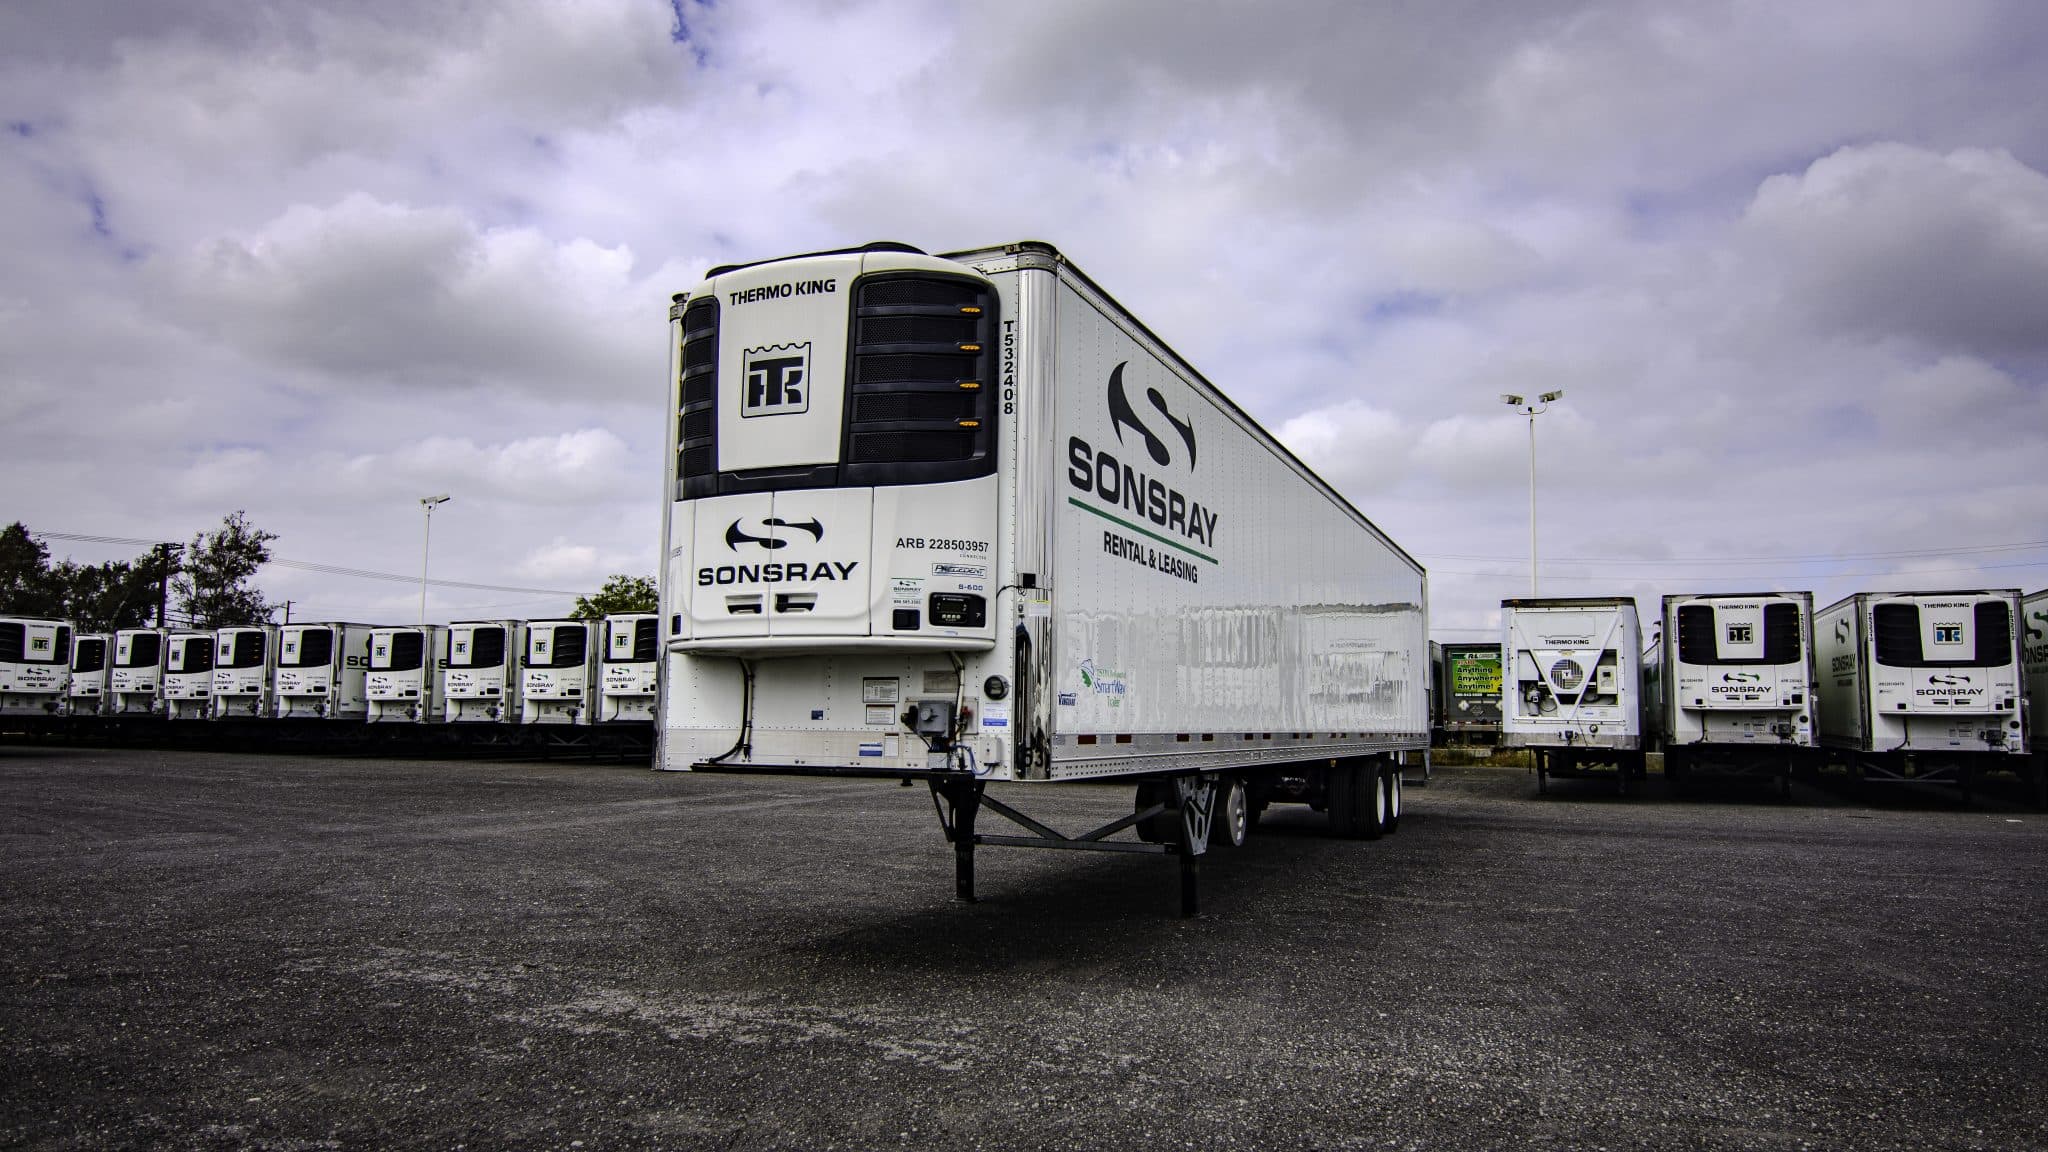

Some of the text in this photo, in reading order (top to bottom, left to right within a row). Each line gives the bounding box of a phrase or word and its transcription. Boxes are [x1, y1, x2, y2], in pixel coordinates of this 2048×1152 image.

[730, 278, 836, 306] THERMO KING
[1003, 320, 1014, 415] T532408
[1068, 435, 1219, 548] SONSRAY
[896, 538, 989, 553] ARB 228503957
[1103, 530, 1198, 584] RENTAL & LEASING
[698, 561, 859, 587] SONSRAY
[1916, 688, 1984, 696] SONSRAY
